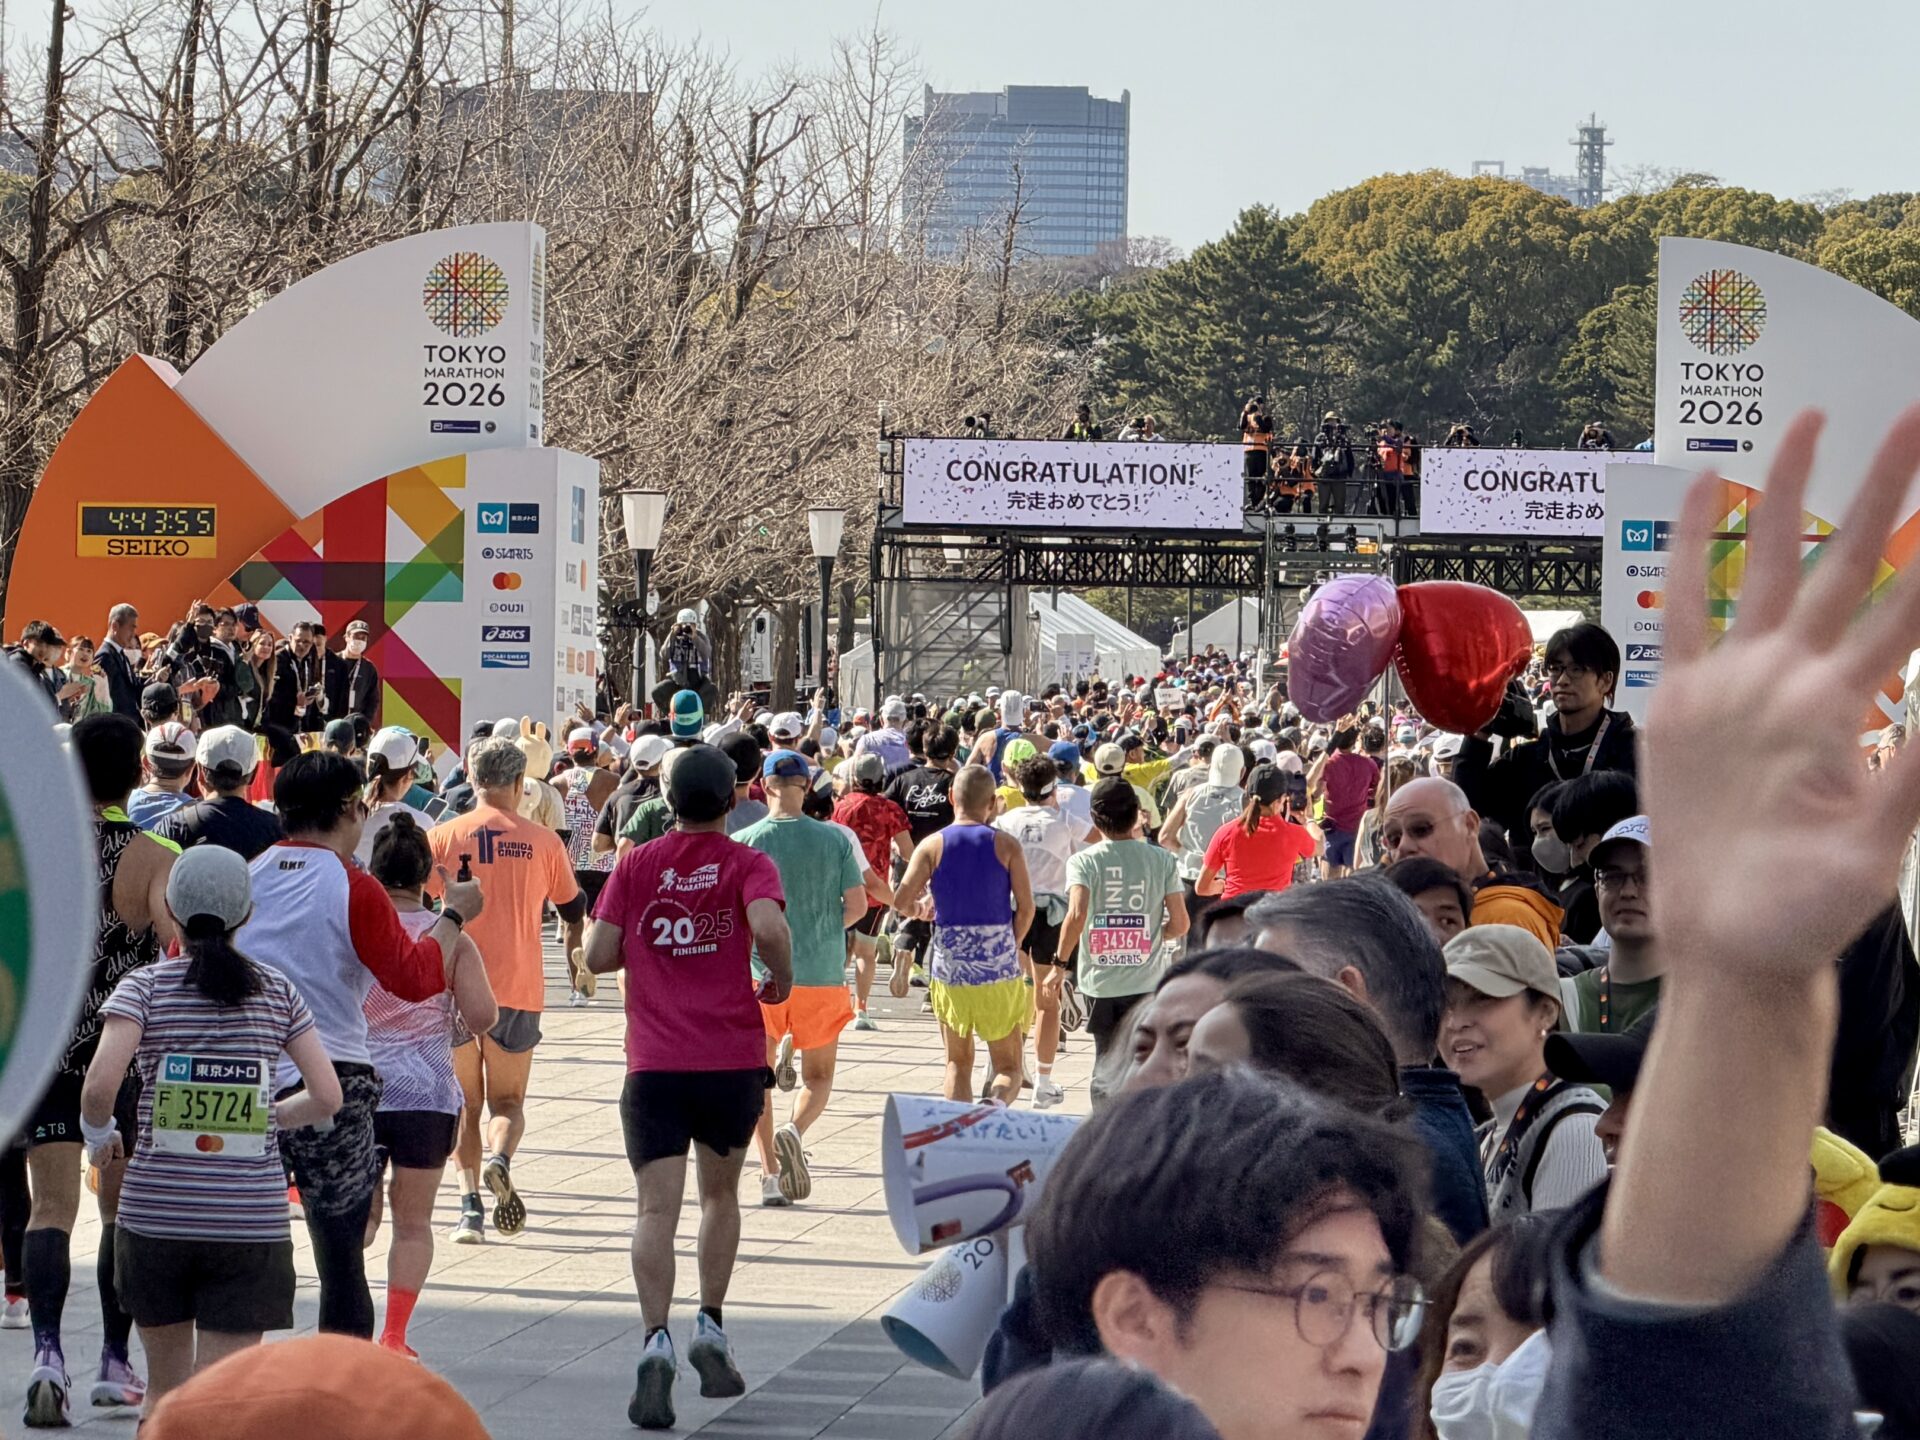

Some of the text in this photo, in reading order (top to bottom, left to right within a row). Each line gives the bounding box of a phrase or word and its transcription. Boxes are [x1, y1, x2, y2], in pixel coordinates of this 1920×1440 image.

[423, 345, 506, 363] TOKYO
[424, 368, 505, 379] MARATHON
[1680, 362, 1764, 382] TOKYO
[423, 382, 505, 407] 2026
[1680, 385, 1762, 397] MARATHON
[1679, 400, 1763, 426] 2026
[947, 459, 1195, 486] CONGRATULATION!
[1463, 469, 1605, 494] CONGRATU
[1007, 490, 1140, 512] 完走おめでとう!
[1524, 501, 1605, 520] 完走おめ
[108, 510, 211, 535] 4:43:55
[107, 539, 190, 557] SEIKO
[494, 548, 534, 560] STARTS
[1640, 566, 1668, 577] STAR
[500, 604, 524, 613] OUJI
[1644, 621, 1663, 632] OU
[1129, 880, 1145, 911] TO
[652, 908, 734, 946] 2025
[1102, 931, 1141, 949] 34367
[672, 943, 718, 957] FINISHER
[195, 1063, 258, 1079] 東京メトロ
[159, 1090, 171, 1107] F
[180, 1089, 253, 1124] 35724
[159, 1116, 167, 1128] 3
[963, 1238, 994, 1271] 20
